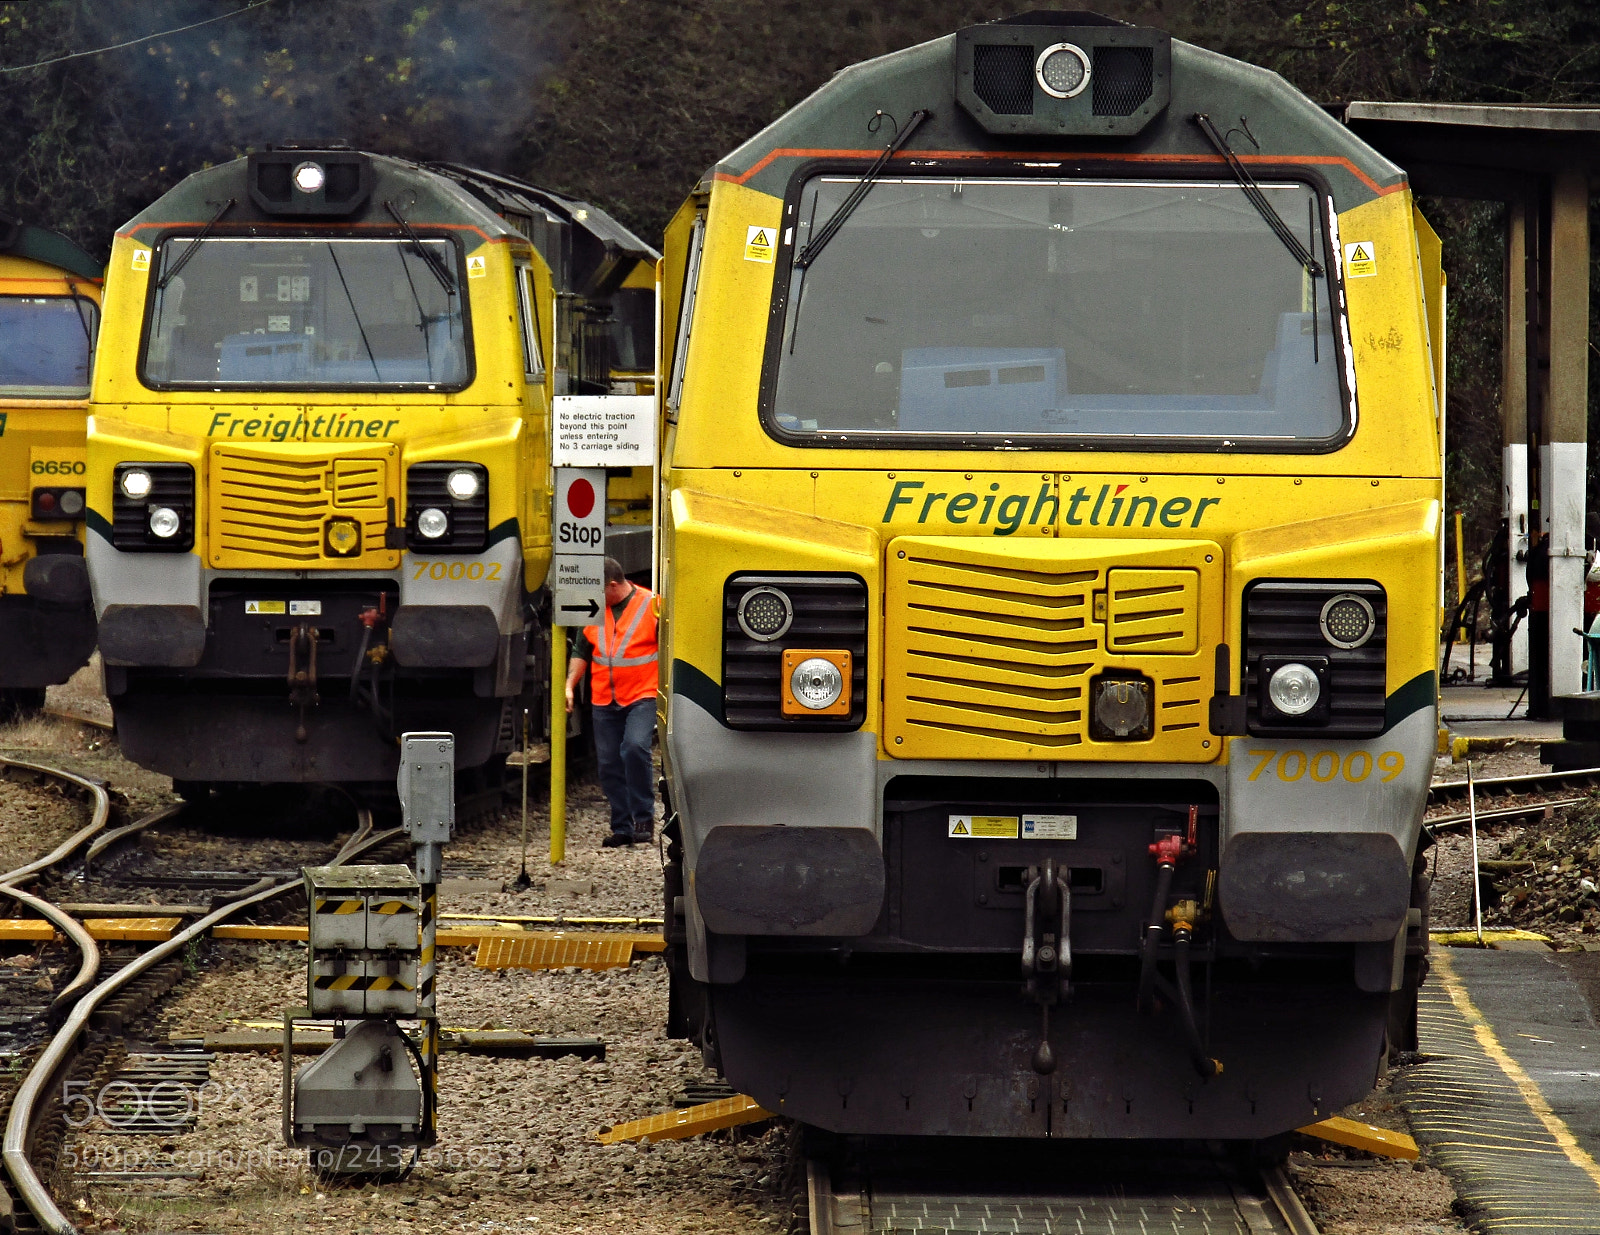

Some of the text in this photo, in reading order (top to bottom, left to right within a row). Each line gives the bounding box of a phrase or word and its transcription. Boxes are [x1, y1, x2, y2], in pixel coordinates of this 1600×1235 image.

[572, 412, 602, 420] electric
[207, 412, 399, 442] Freightliner
[559, 423, 587, 431] beyond
[607, 423, 627, 431] point
[559, 432, 619, 441] unless entering
[559, 442, 640, 452] No 3 carriage siding
[881, 480, 1221, 536] Freightliner
[559, 522, 602, 548] Stop
[413, 561, 502, 581] 70002
[559, 564, 580, 573] Await
[558, 575, 601, 585] instructions
[1246, 749, 1406, 784] 70009
